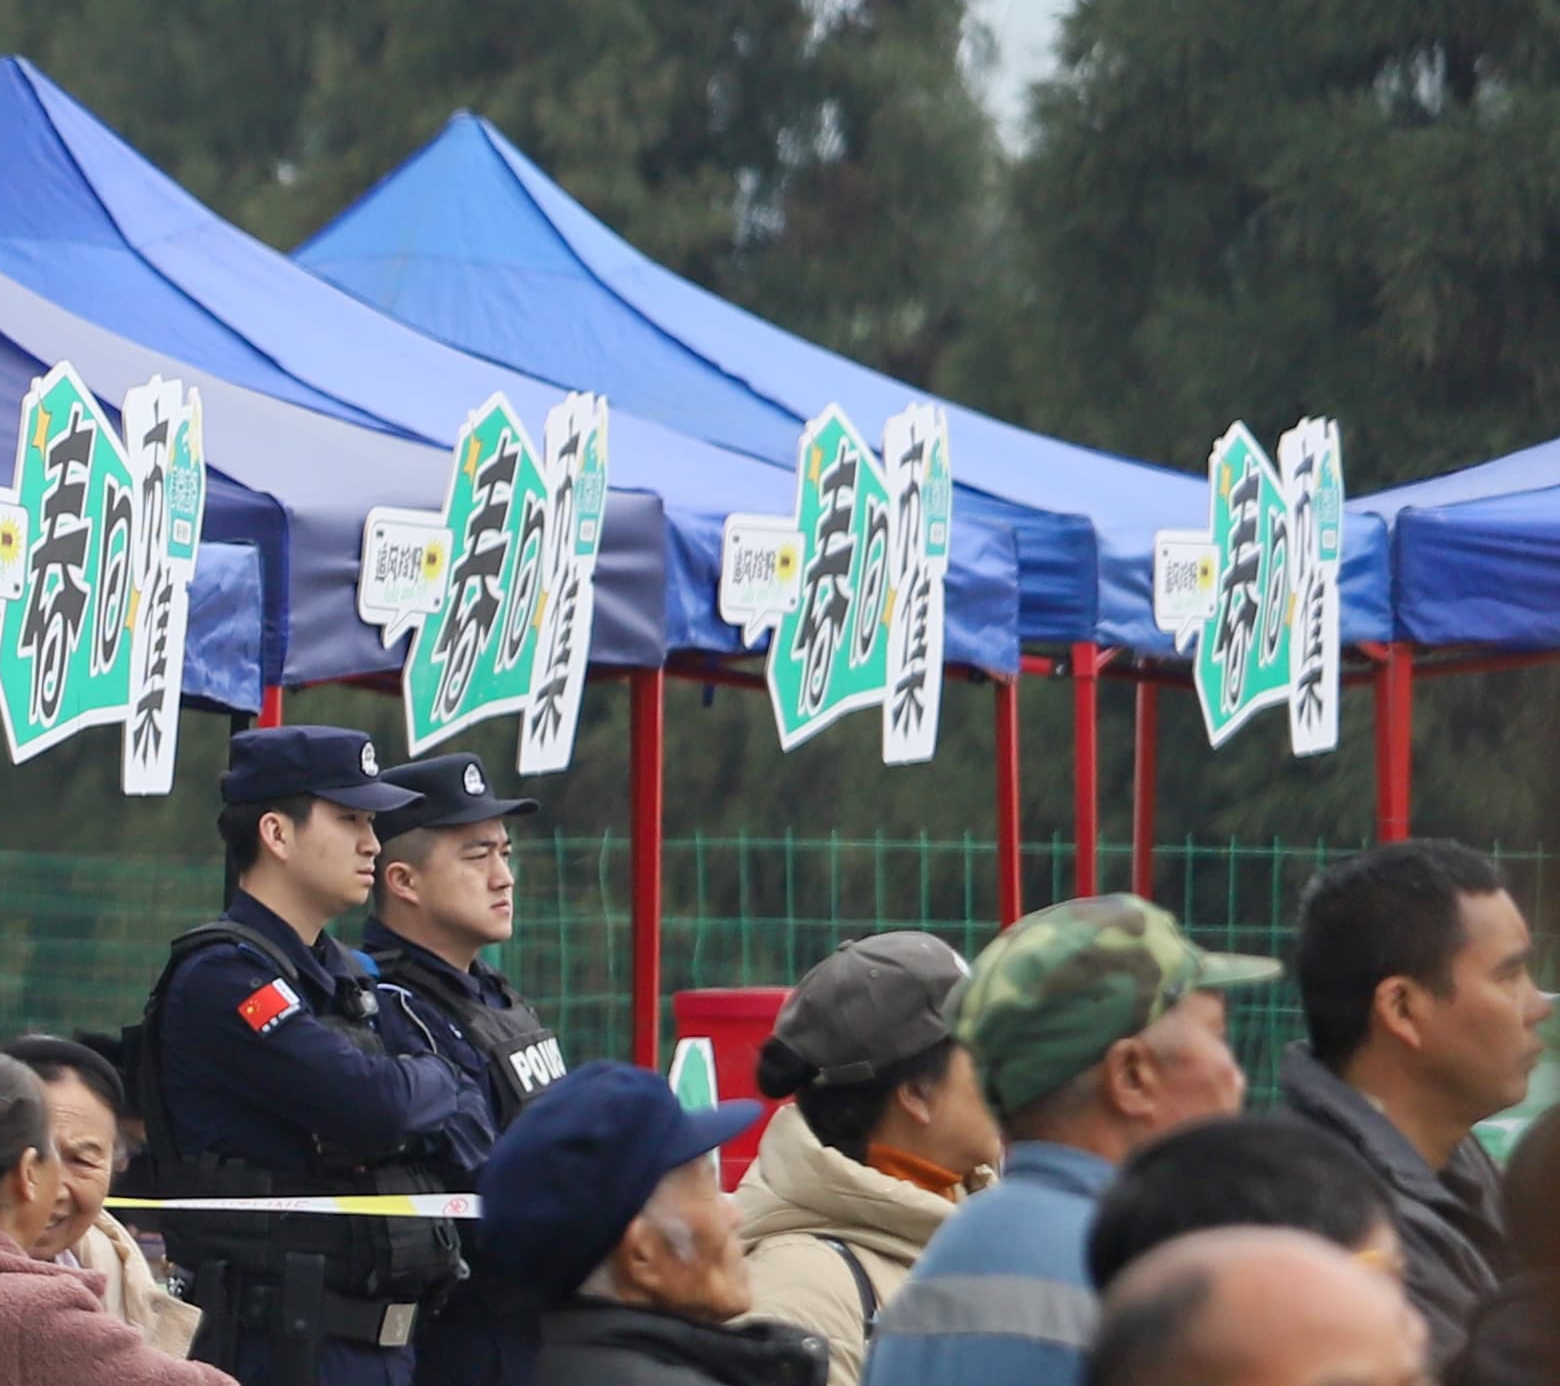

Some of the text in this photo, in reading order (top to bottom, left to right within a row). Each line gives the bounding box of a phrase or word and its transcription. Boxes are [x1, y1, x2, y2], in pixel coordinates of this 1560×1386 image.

[22, 411, 131, 723] 春日
[132, 396, 174, 765] 市集
[435, 429, 545, 715] 春日
